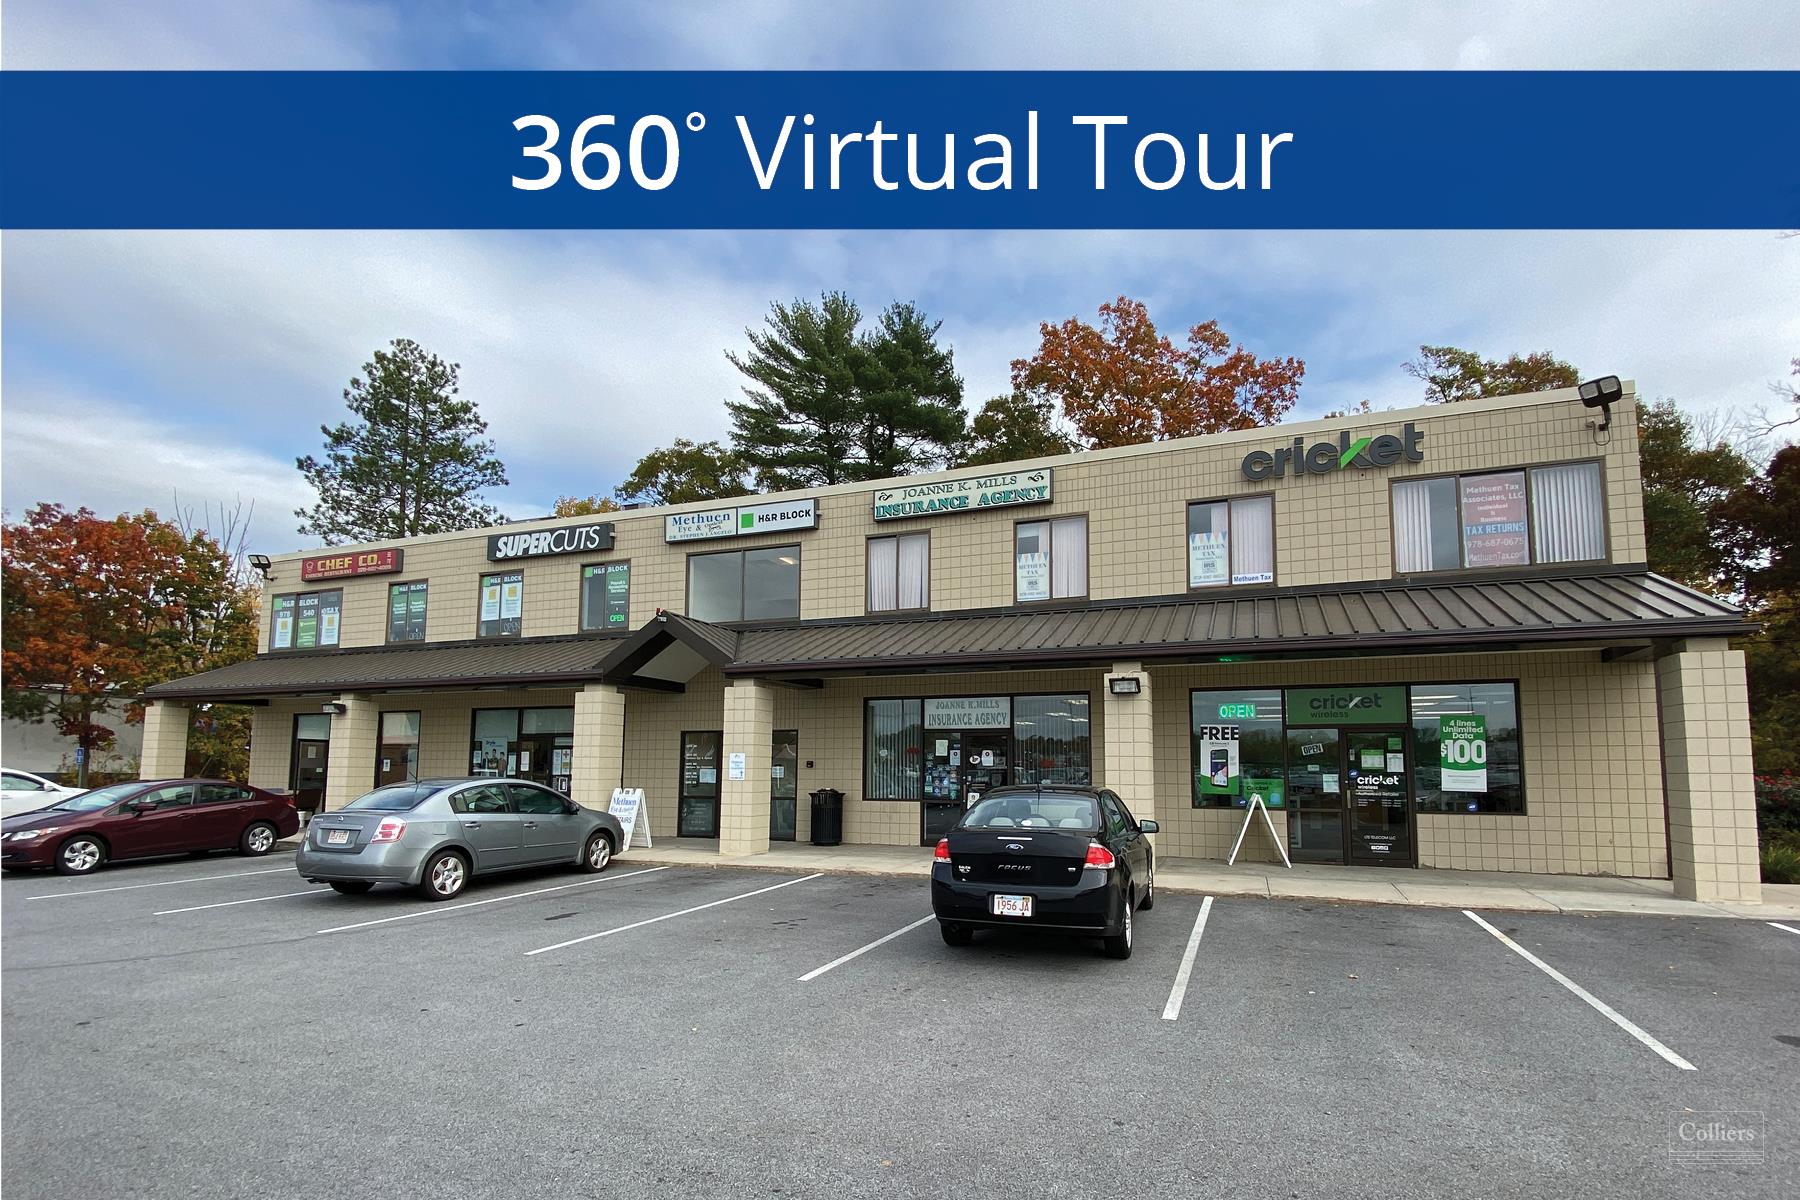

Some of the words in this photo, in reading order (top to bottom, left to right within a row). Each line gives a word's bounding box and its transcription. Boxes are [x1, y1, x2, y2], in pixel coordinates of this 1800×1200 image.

[1242, 423, 1425, 482] cricket
[902, 484, 954, 500] JOANNE
[958, 482, 972, 491] K.
[976, 476, 1018, 489] MILLS
[1466, 485, 1503, 494] Methuen
[876, 495, 969, 518] INSURANCE
[977, 485, 1049, 506] AGENCY
[1463, 494, 1507, 503] Associates,
[672, 512, 731, 526] Methuen
[758, 513, 777, 523] H&R
[780, 509, 811, 520] BLOCK
[678, 525, 692, 533] Eye
[1466, 526, 1484, 535] TAX
[1486, 522, 1524, 533] RETURNS
[496, 526, 600, 558] SUPERCUTS
[317, 557, 352, 571] CHEF
[358, 554, 381, 567] CO.
[608, 565, 628, 573] BLOCK
[610, 614, 625, 622] OPEN
[936, 700, 966, 710] JOANNE
[1309, 692, 1382, 710] cricket
[1219, 704, 1255, 718] OPEN
[1310, 710, 1349, 719] wireless
[929, 713, 973, 726] INSURANCE
[975, 712, 1007, 725] AGENCY
[1200, 727, 1239, 740] FREE
[1303, 744, 1322, 755] OPEN
[1441, 739, 1487, 764] $100
[1356, 775, 1399, 785] cricket
[997, 900, 1017, 911] 1956
